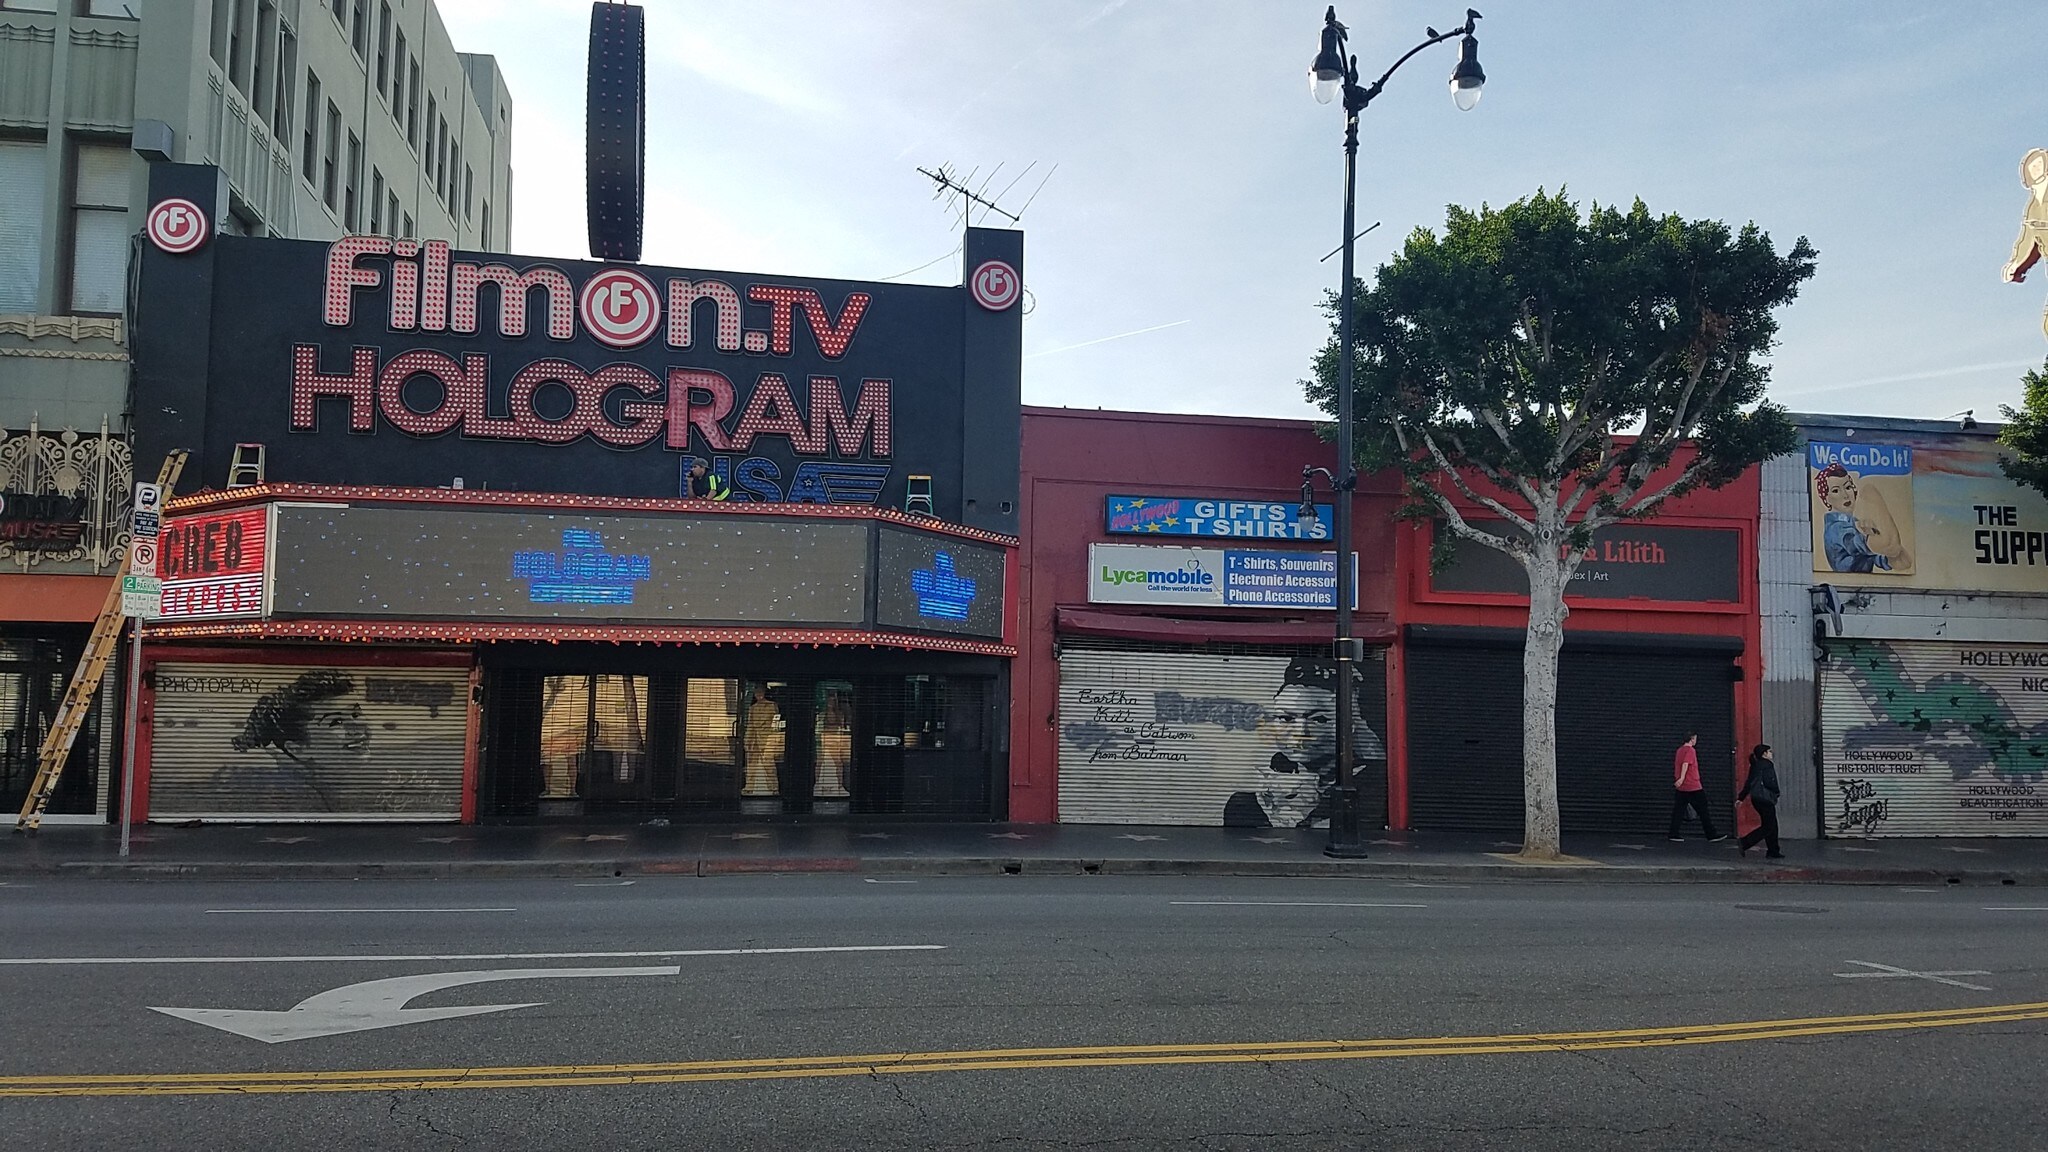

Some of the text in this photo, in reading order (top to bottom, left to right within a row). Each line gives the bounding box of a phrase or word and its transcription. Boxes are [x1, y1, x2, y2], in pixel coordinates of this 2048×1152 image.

[292, 344, 892, 456] HOLOGRAM
[1814, 445, 1909, 467] We Can Do It!
[1194, 501, 1286, 521] GIFTS
[1973, 505, 2018, 526] THE
[1185, 518, 1327, 539] T SHIRTS
[164, 519, 243, 576] CRE8
[1604, 541, 1665, 563] Lilith
[514, 551, 650, 581] HOLOGRAM
[1244, 557, 1278, 571] Shirts,
[1280, 558, 1334, 571] Souvenirs
[126, 577, 133, 588] 2
[1102, 565, 1213, 585] Lycamobile
[1229, 573, 1337, 588] Electronic Accessor
[1593, 571, 1609, 581] Art
[1229, 589, 1331, 603] Phone Accessories
[1960, 650, 2048, 667] HOLLYWO
[160, 677, 262, 693] PHOTOPLAY
[1079, 689, 1138, 705] Eartha
[1093, 706, 1137, 723] Kitt
[1124, 726, 1136, 734] as
[1088, 745, 1189, 763] from Batman
[1844, 751, 1914, 760] HOLLYWOOD
[1837, 764, 1923, 774] HISTORIC TRUST
[1968, 786, 2037, 796] HOLLYWOOD
[1960, 798, 2045, 808] BEAUTIFICATION
[1988, 811, 2018, 821] TEAM
